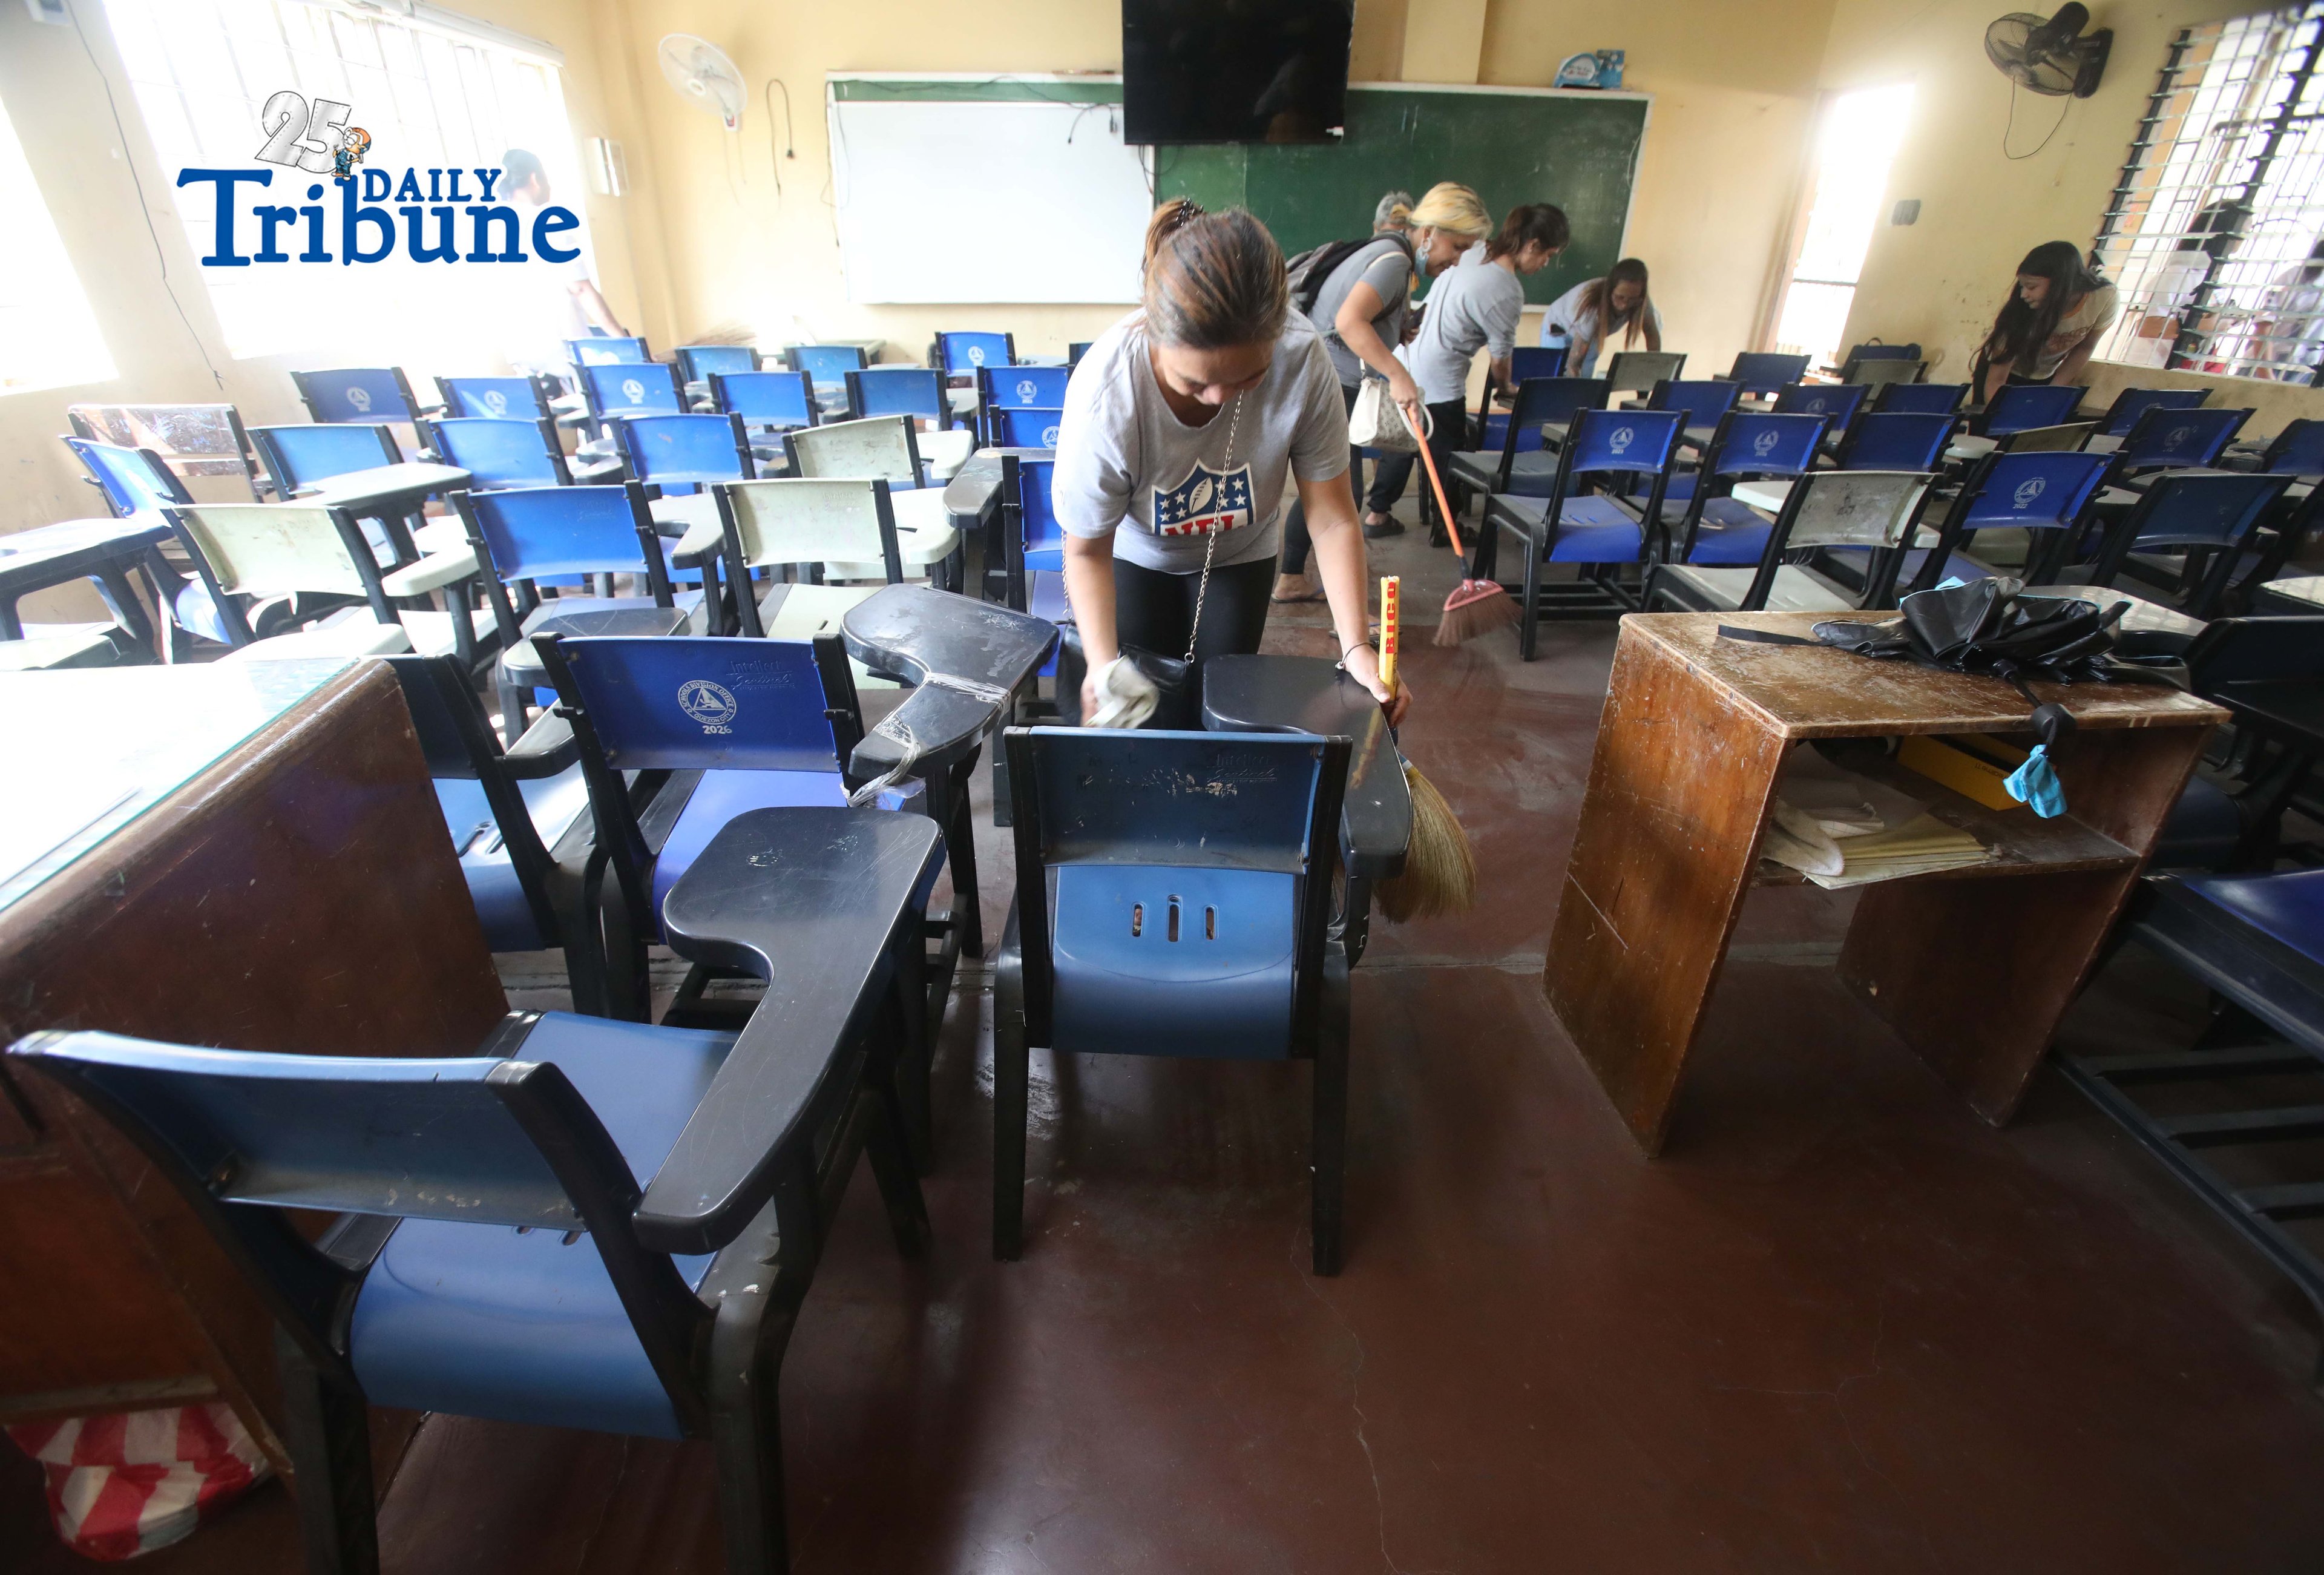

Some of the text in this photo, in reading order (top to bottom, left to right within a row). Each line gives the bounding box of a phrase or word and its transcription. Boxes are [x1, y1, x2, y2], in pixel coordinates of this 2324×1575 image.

[680, 682, 734, 708] SCHOOLS DIVISION OFFICE
[694, 712, 731, 723] QUEZON CITY
